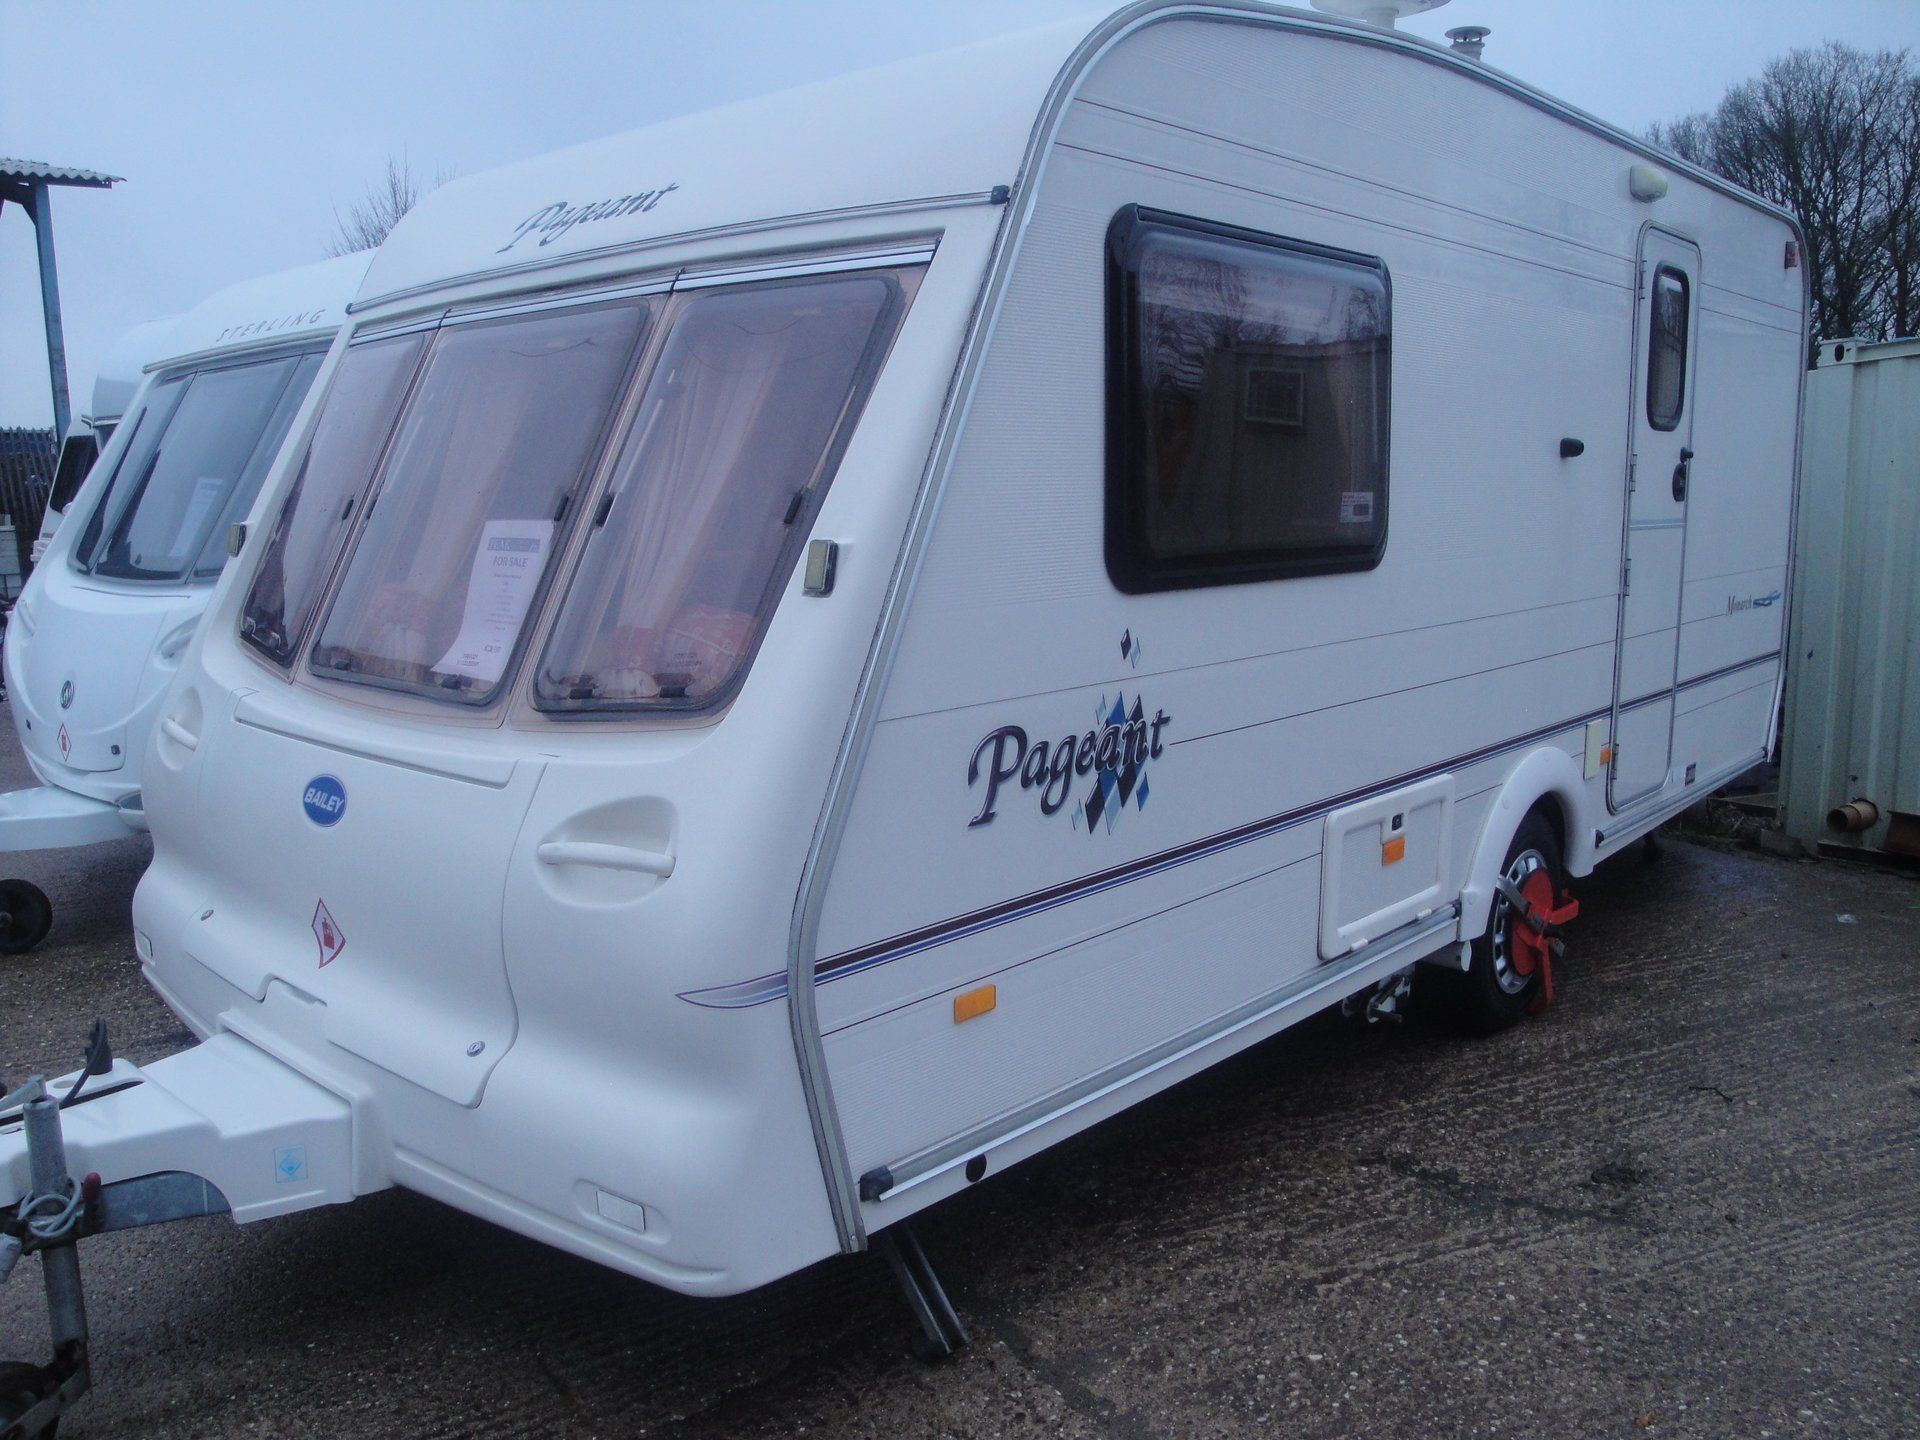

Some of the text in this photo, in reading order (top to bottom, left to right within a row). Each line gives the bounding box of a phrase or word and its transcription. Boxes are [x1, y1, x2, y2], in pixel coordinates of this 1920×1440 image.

[495, 183, 679, 253] Pageant
[216, 308, 326, 342] STERLING
[493, 556, 528, 567] FOR SALE
[967, 708, 1171, 828] Pageant
[304, 787, 345, 813] BAILEY
